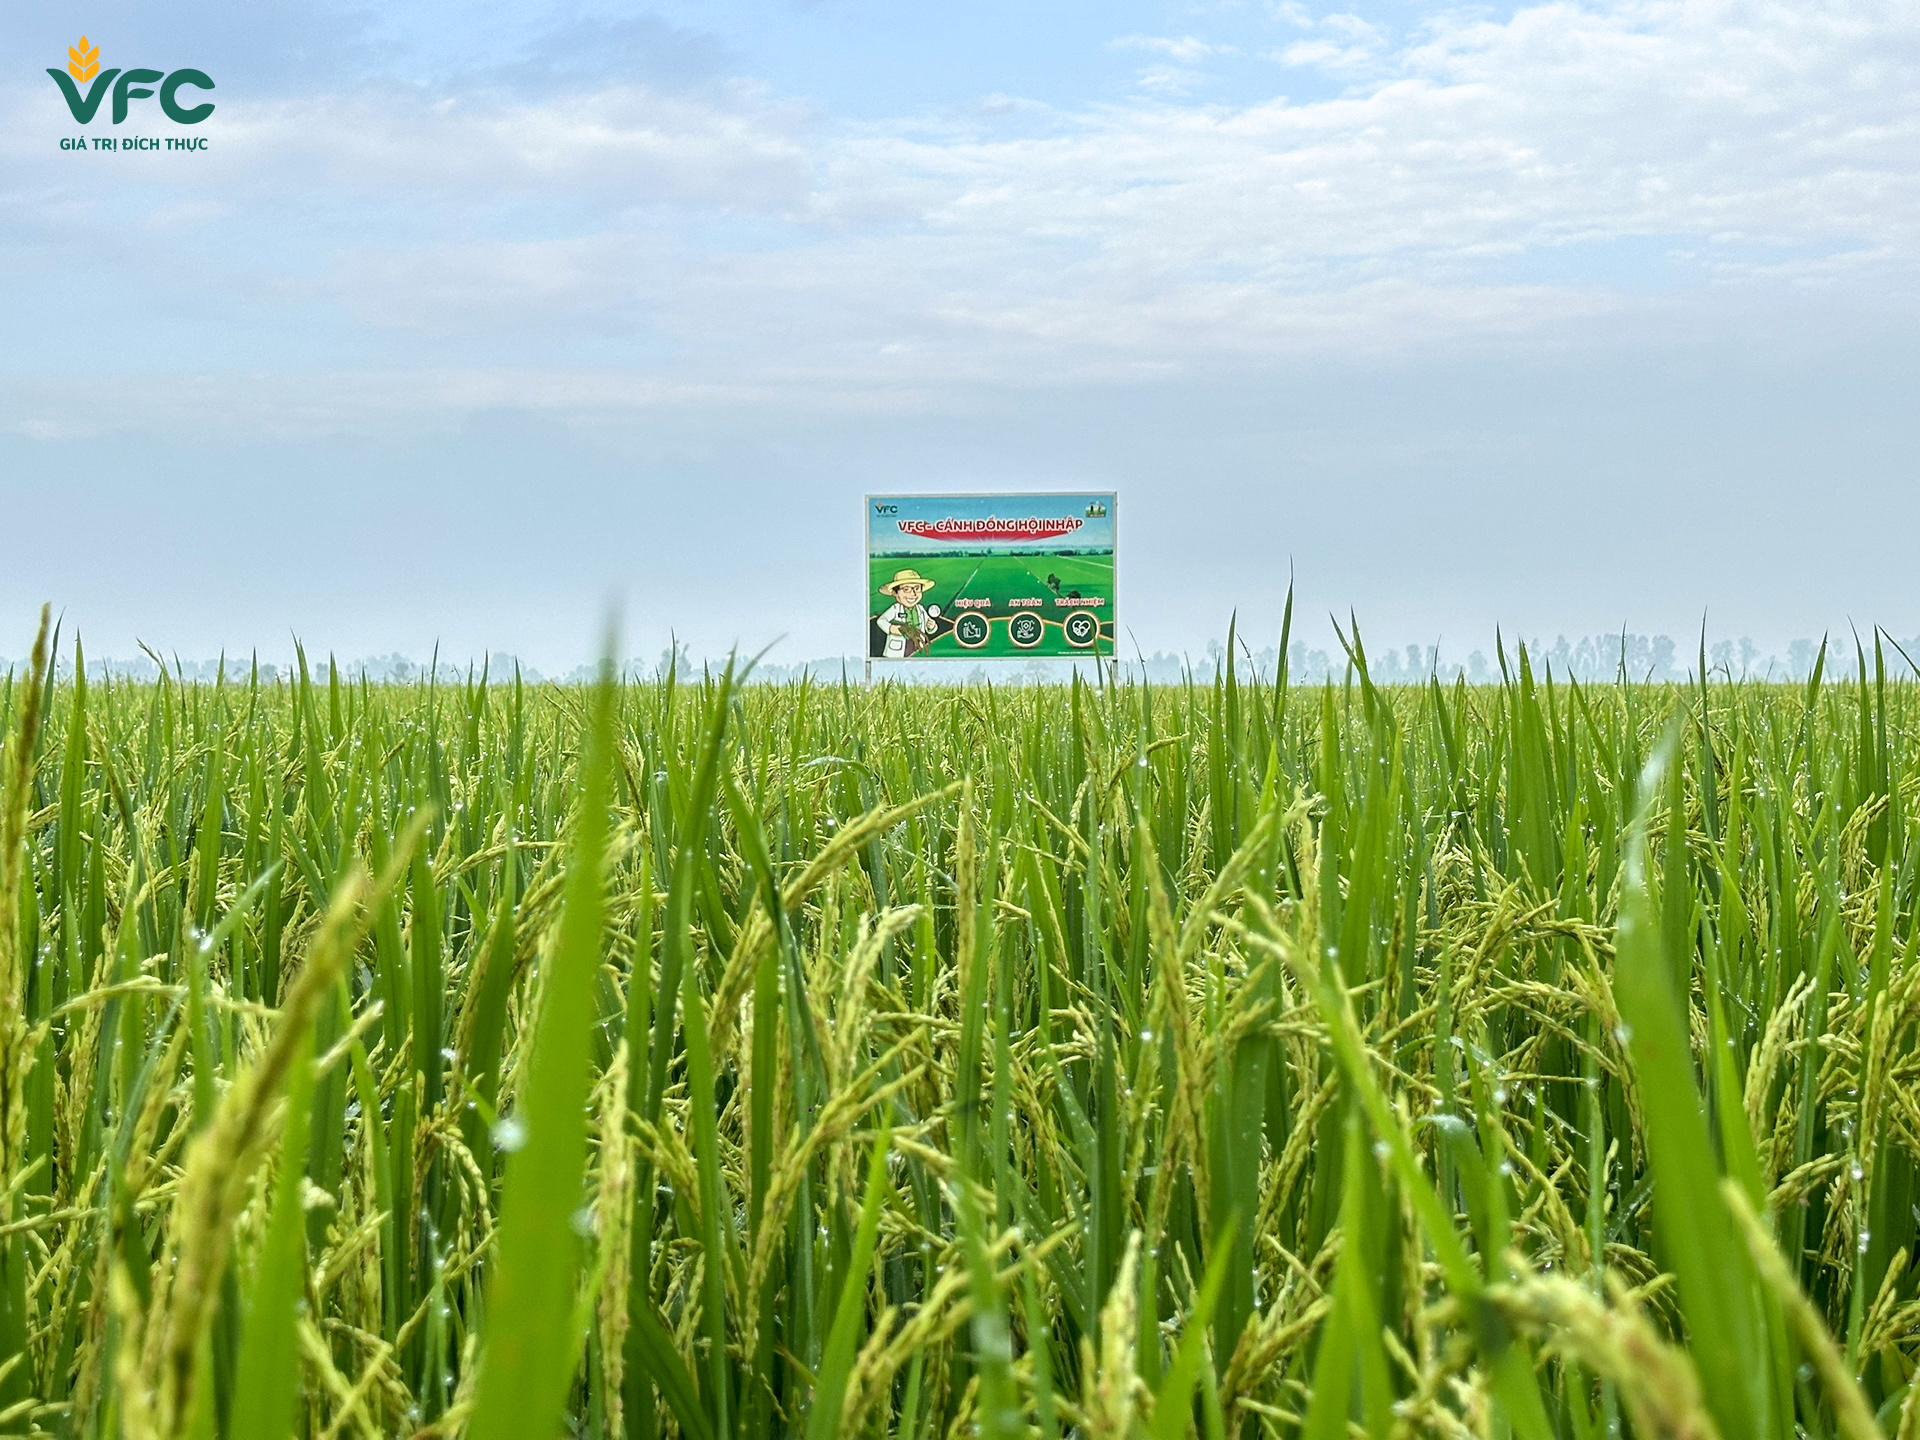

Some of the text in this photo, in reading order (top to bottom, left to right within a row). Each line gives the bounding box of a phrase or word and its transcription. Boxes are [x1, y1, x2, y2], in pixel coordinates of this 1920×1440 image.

[875, 505, 898, 514] VFC
[898, 521, 924, 532] VFC
[936, 518, 973, 531] CÁNH
[1018, 517, 1042, 533] HỘI
[1045, 516, 1083, 532] NHẬP
[1009, 599, 1020, 607] AN
